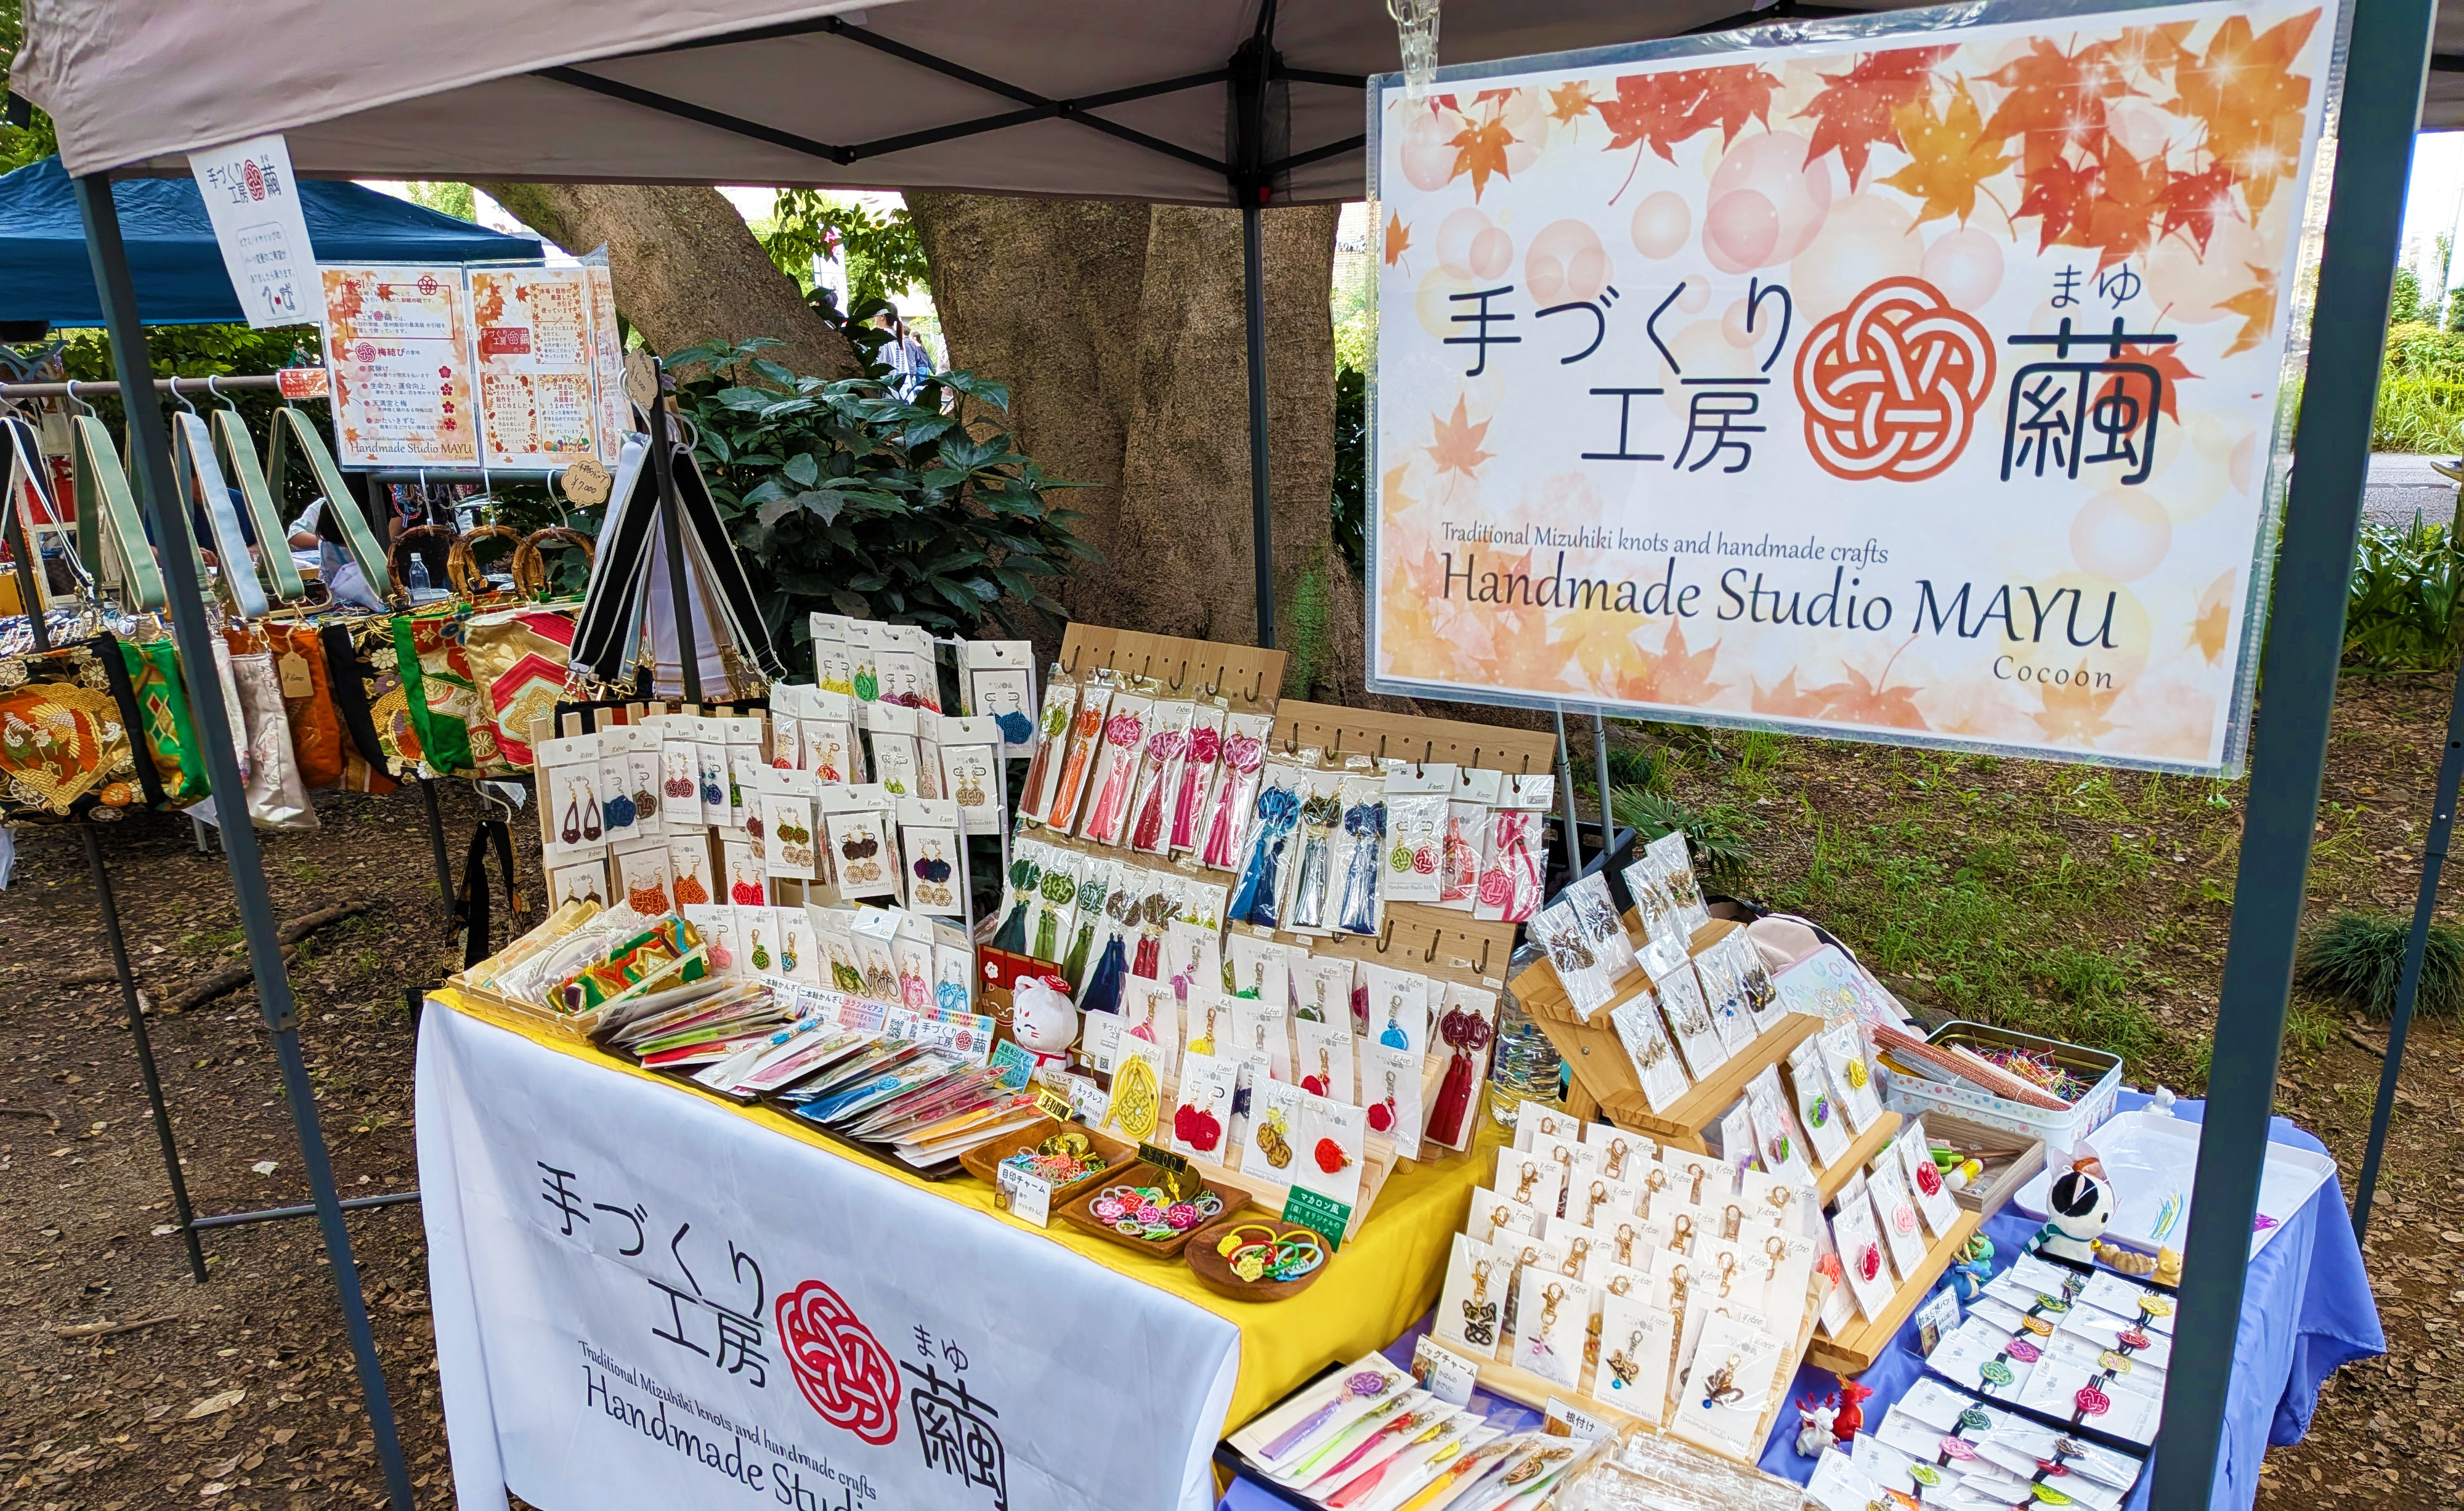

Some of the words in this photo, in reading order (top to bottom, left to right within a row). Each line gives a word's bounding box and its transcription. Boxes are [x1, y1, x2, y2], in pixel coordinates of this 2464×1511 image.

[207, 163, 243, 188] 手づくり
[261, 164, 281, 196] 繭
[229, 183, 248, 204] 工房
[2051, 264, 2141, 311] まゆ
[482, 330, 508, 338] 手づくり
[1443, 277, 1793, 377] 手づくり
[2001, 317, 2177, 485] 繭
[1581, 376, 1770, 475] 工房
[351, 442, 405, 453] Handmade
[408, 443, 438, 453] Studio
[441, 444, 472, 453] MAYU
[1441, 522, 1528, 547] Traditional
[1534, 524, 1612, 550] Mizuhiki
[1619, 527, 1668, 553] knots
[1674, 530, 1710, 556] and
[1717, 532, 1825, 562] handmade
[1830, 537, 1889, 570] crafts
[1441, 552, 1701, 618] Handmade
[1717, 568, 1892, 632] Studio
[1912, 579, 2119, 650] MAYU
[1993, 656, 2113, 689] Cocoon
[845, 1000, 883, 1013] カラフルピアス
[922, 1023, 957, 1038] 手づくり
[934, 1036, 954, 1048] 工房
[972, 1037, 987, 1055] 繭
[999, 1043, 1033, 1063] 高級水引アク
[1045, 1072, 1072, 1084] イヤリング
[1042, 1094, 1063, 1114] ¥800
[1077, 1085, 1103, 1104] ネックレス
[1002, 1169, 1045, 1194] 目印チャーム
[1301, 1193, 1339, 1214] マカロン風
[1305, 1210, 1340, 1229] オリジナルの
[537, 1161, 764, 1318] 手づくり
[648, 1279, 769, 1388] 工房
[914, 1324, 969, 1374] まゆ
[1418, 1343, 1475, 1377] バッグチャーム
[1597, 1393, 1624, 1409] Handmade
[578, 1340, 638, 1387] Traditional
[641, 1376, 694, 1415] Mizuhiki
[696, 1400, 732, 1433] knots
[736, 1420, 761, 1446] and
[764, 1427, 835, 1480] handmade
[838, 1472, 877, 1501] crafts
[582, 1364, 764, 1491] Handmade
[1566, 1410, 1595, 1432] 根付け
[1680, 1414, 1709, 1432] Handmade
[901, 1360, 1007, 1511] 繭
